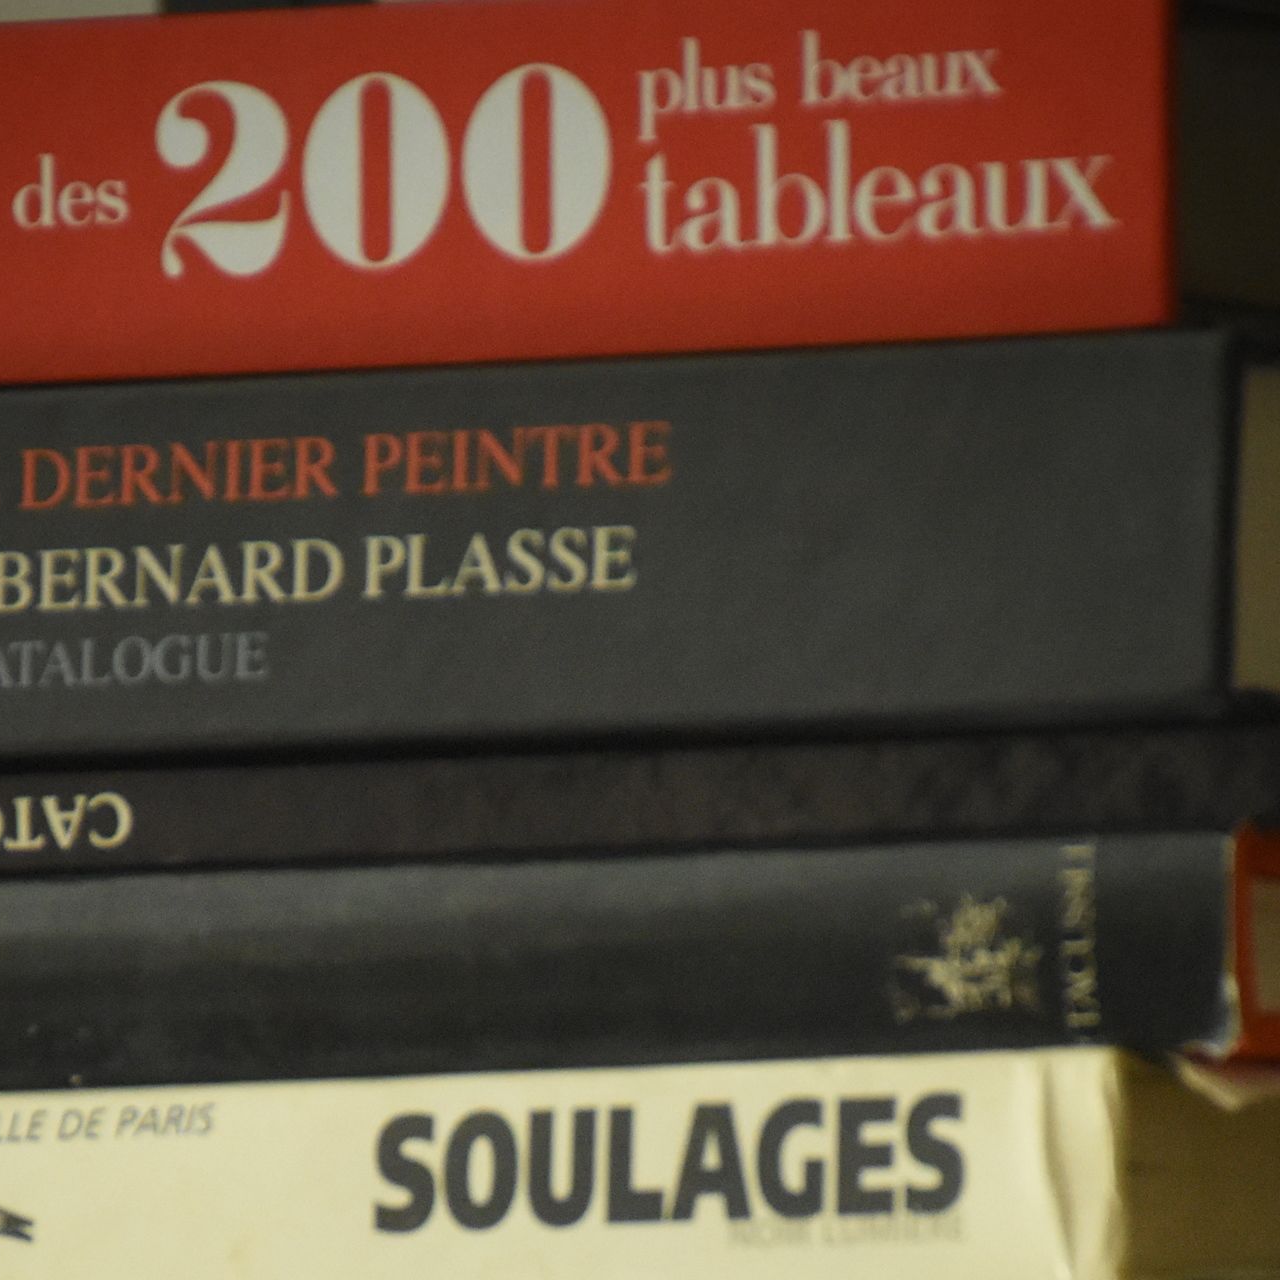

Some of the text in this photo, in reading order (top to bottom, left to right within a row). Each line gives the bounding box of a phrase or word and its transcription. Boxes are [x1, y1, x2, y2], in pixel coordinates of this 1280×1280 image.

[640, 31, 1002, 140] plus beaux
[12, 155, 127, 229] des
[156, 63, 611, 278] 200
[642, 120, 1117, 253] tableaux
[19, 438, 338, 511] DERNIER
[362, 421, 672, 497] PEINTRE
[362, 526, 638, 597] PLASSE
[57, 1106, 105, 1141] DE
[117, 1101, 217, 1137] PARIS
[372, 1089, 969, 1236] SOULAGES
